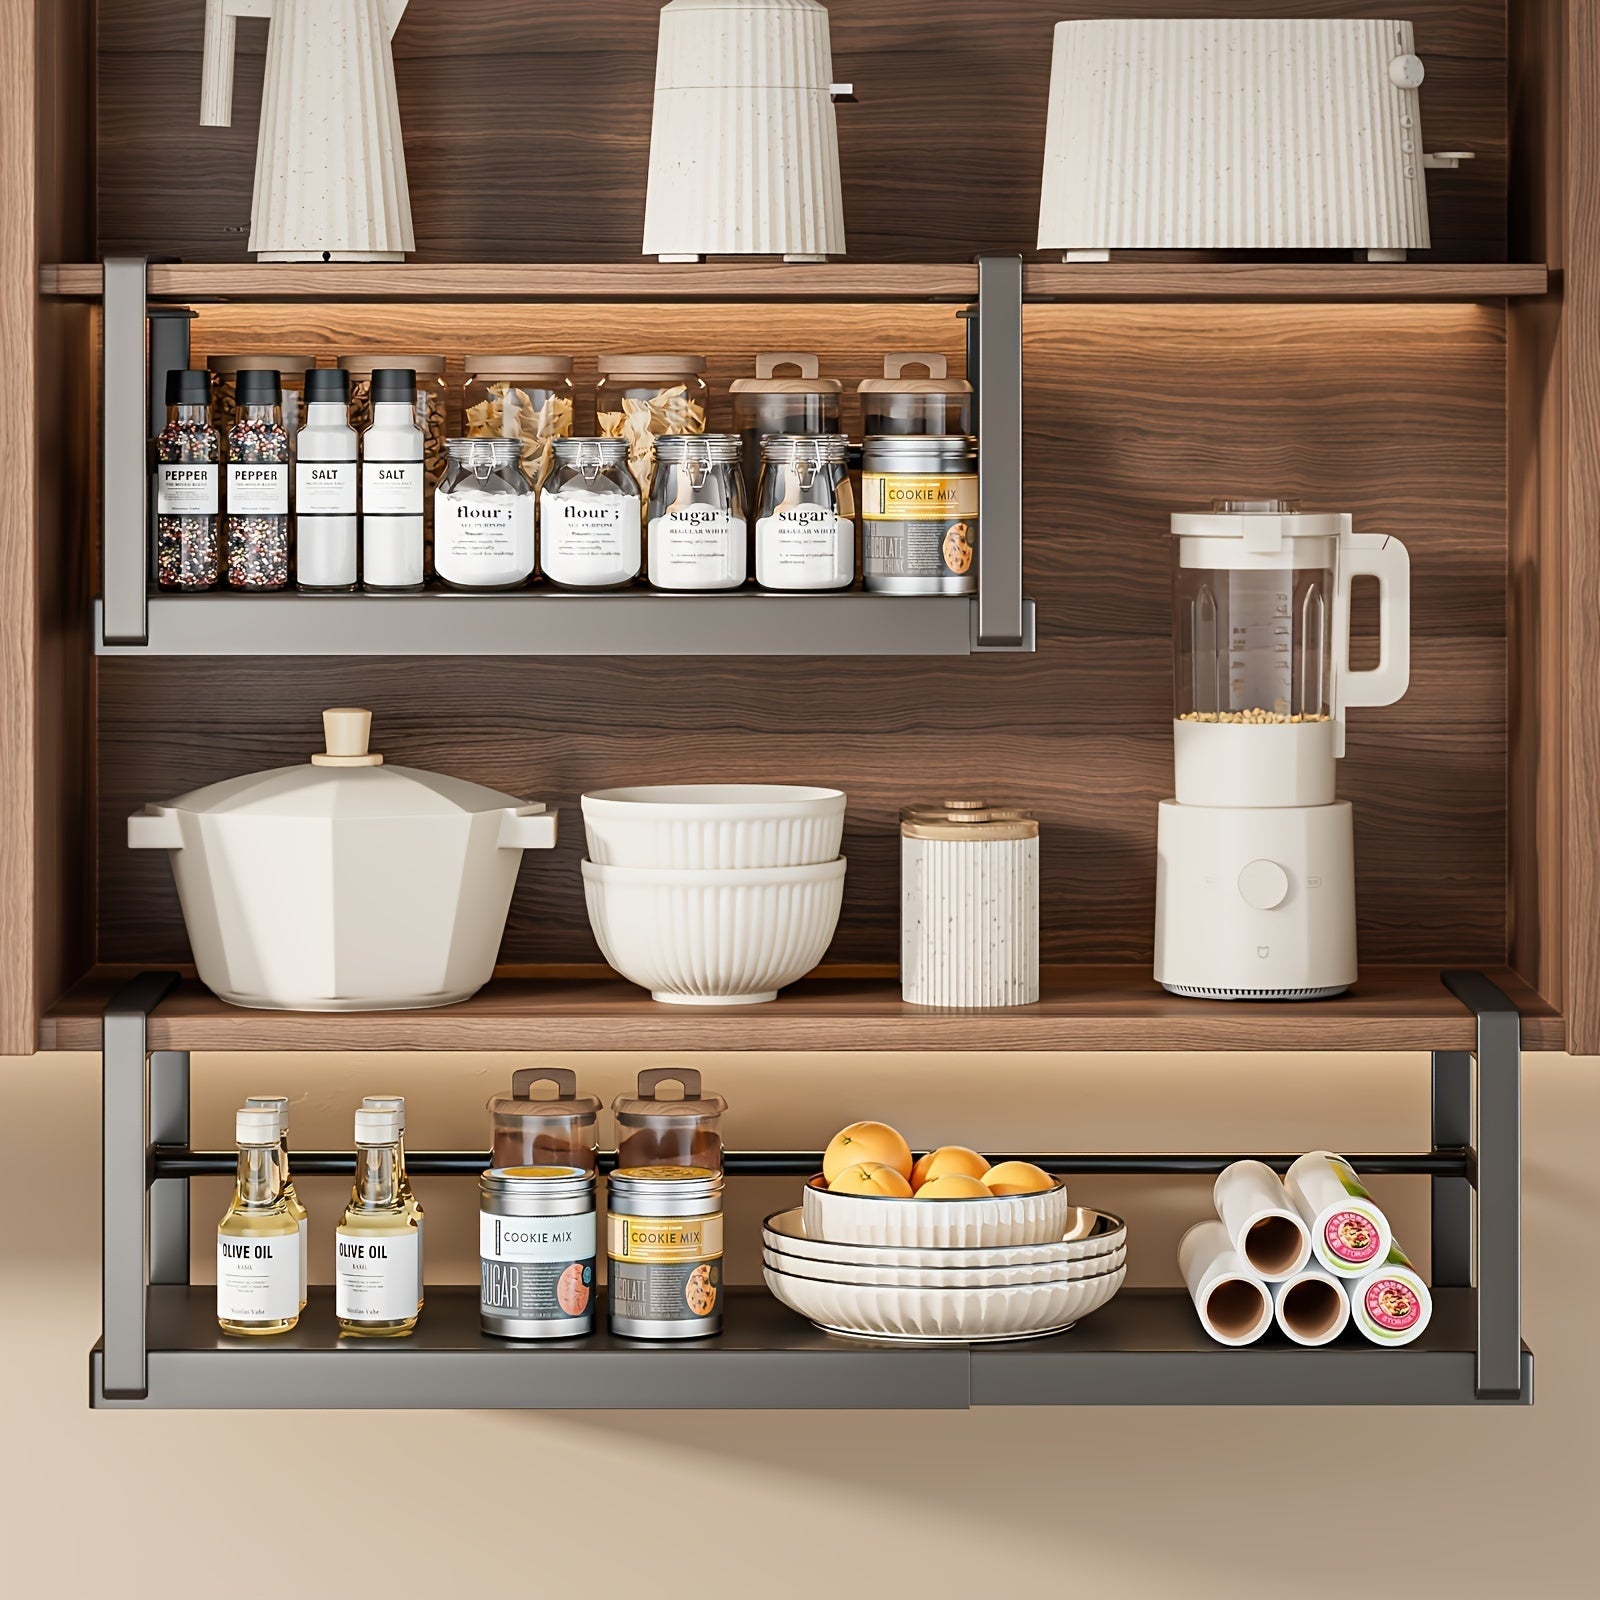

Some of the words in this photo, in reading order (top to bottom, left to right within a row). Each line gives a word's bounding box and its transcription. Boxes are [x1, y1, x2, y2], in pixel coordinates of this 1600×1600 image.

[165, 470, 208, 480] PEPPER
[235, 470, 278, 480] PEPPER
[312, 470, 338, 480] SALT
[379, 470, 405, 480] SALT
[888, 490, 934, 500] COOKIE
[937, 490, 957, 500] MIX
[457, 506, 502, 518] flour
[564, 506, 609, 518] flour
[670, 512, 719, 526] sugar
[778, 512, 828, 526] sugar
[504, 1232, 548, 1243] COOKIE
[552, 1232, 572, 1242] MIX
[631, 1233, 676, 1244] COOKIE
[680, 1232, 700, 1243] MIX
[222, 1243, 250, 1259] OLIVE
[254, 1245, 273, 1259] OIL
[339, 1242, 364, 1258] OLIVE
[369, 1245, 388, 1259] OIL
[482, 1261, 519, 1308] SUGAR
